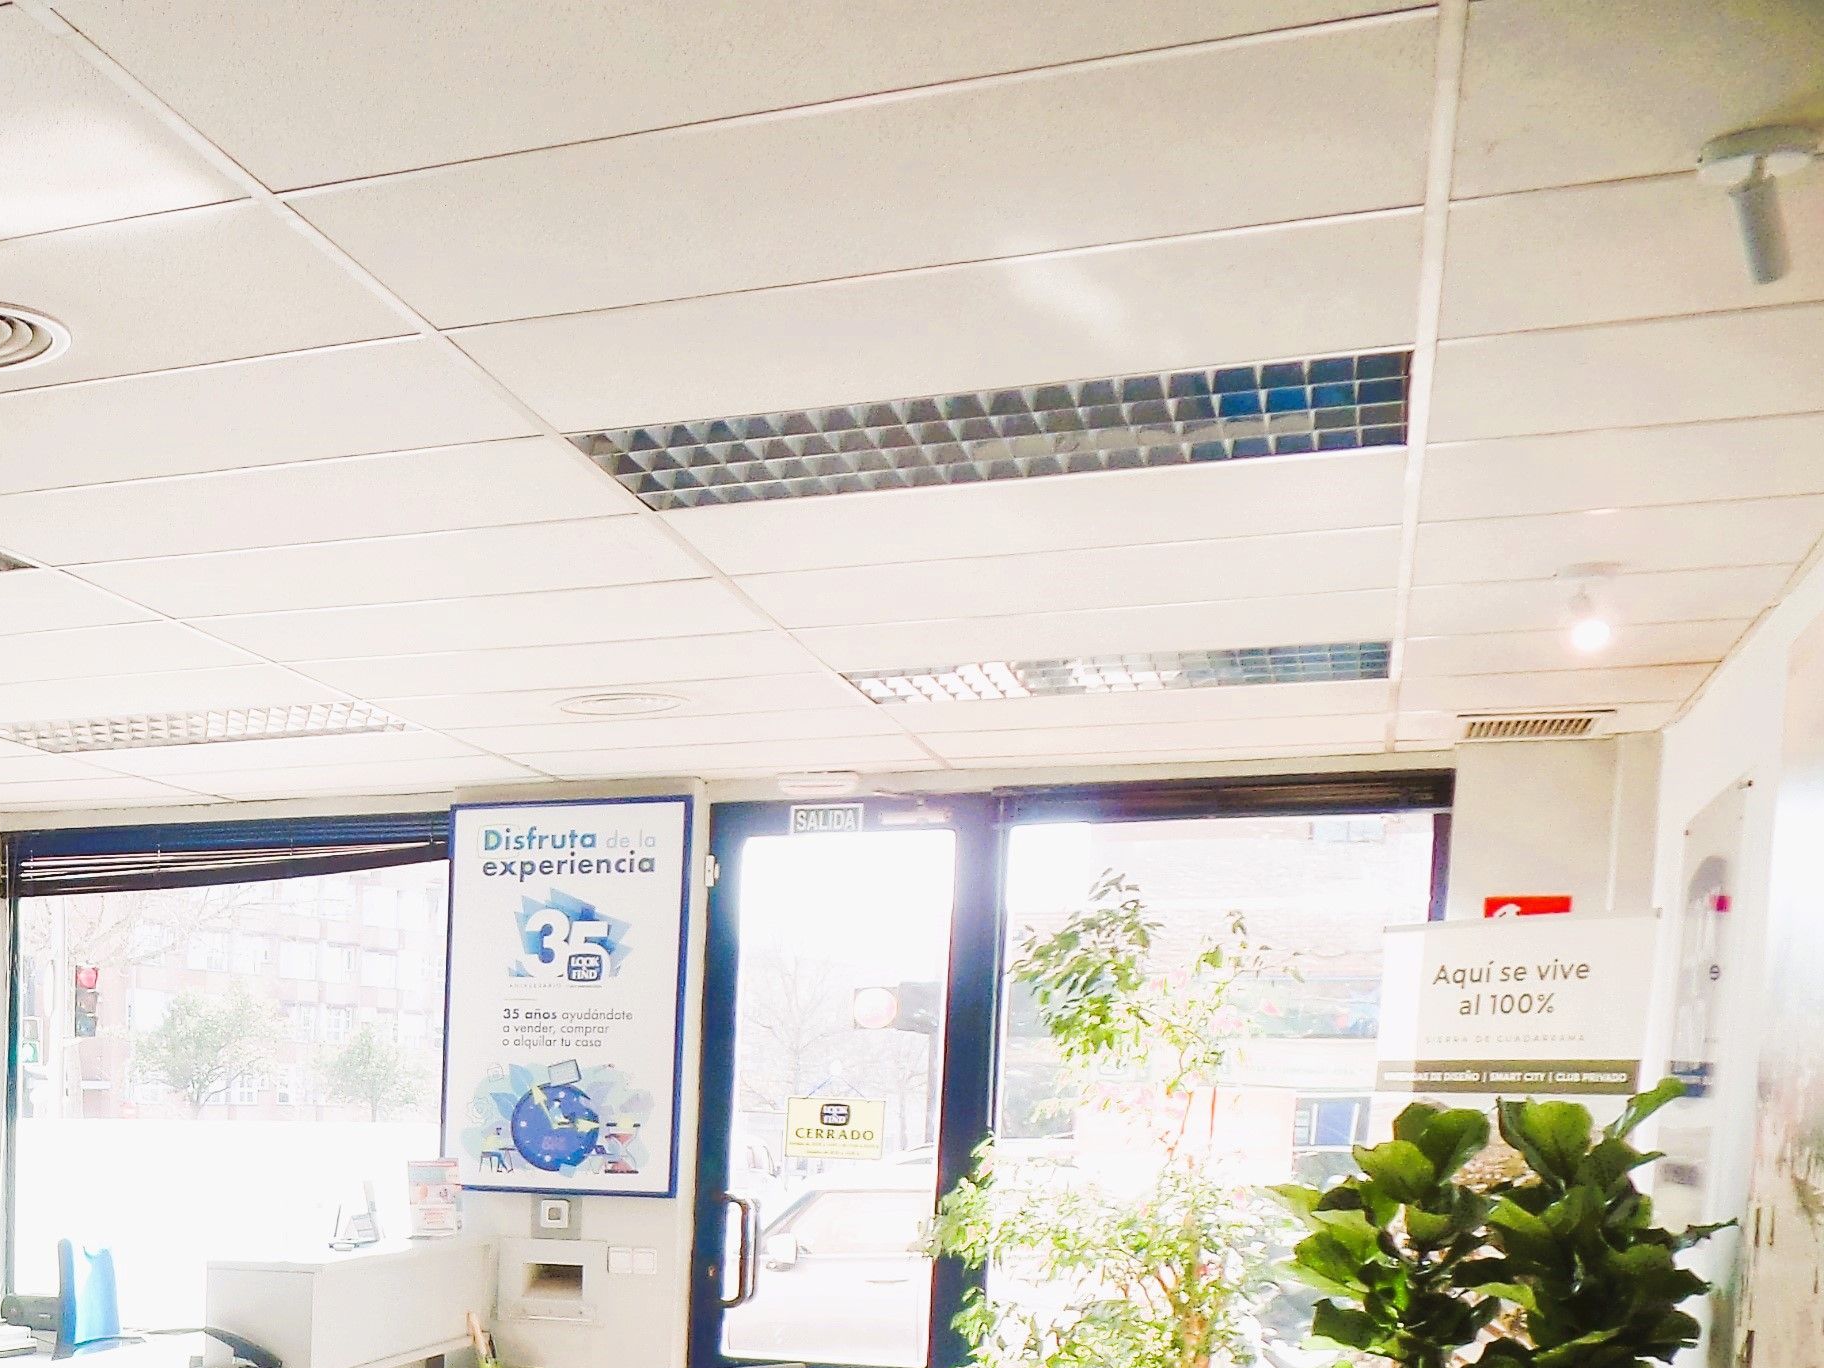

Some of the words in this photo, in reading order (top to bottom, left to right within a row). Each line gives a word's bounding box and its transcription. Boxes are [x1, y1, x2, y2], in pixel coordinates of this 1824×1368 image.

[796, 809, 856, 831] SALIDA
[484, 826, 597, 851] Disfruta
[606, 829, 630, 848] de
[639, 829, 656, 848] la
[482, 850, 656, 882] experiencia
[522, 908, 612, 980] 35
[570, 956, 601, 967] LOOK
[1432, 960, 1495, 989] Aquí
[1499, 966, 1527, 982] se
[1537, 959, 1590, 981] vive
[503, 1008, 520, 1019] 35
[525, 1008, 557, 1020] años
[561, 1008, 633, 1022] ayudándote
[1459, 994, 1481, 1015] al
[1490, 993, 1555, 1015] 100%
[502, 1025, 510, 1033] a
[513, 1021, 556, 1035] vender,
[560, 1025, 610, 1036] comprar
[502, 1038, 510, 1046] o
[513, 1035, 557, 1049] alquilar
[561, 1037, 571, 1047] tu
[575, 1038, 602, 1047] casa
[795, 1127, 874, 1141] CERRADO
